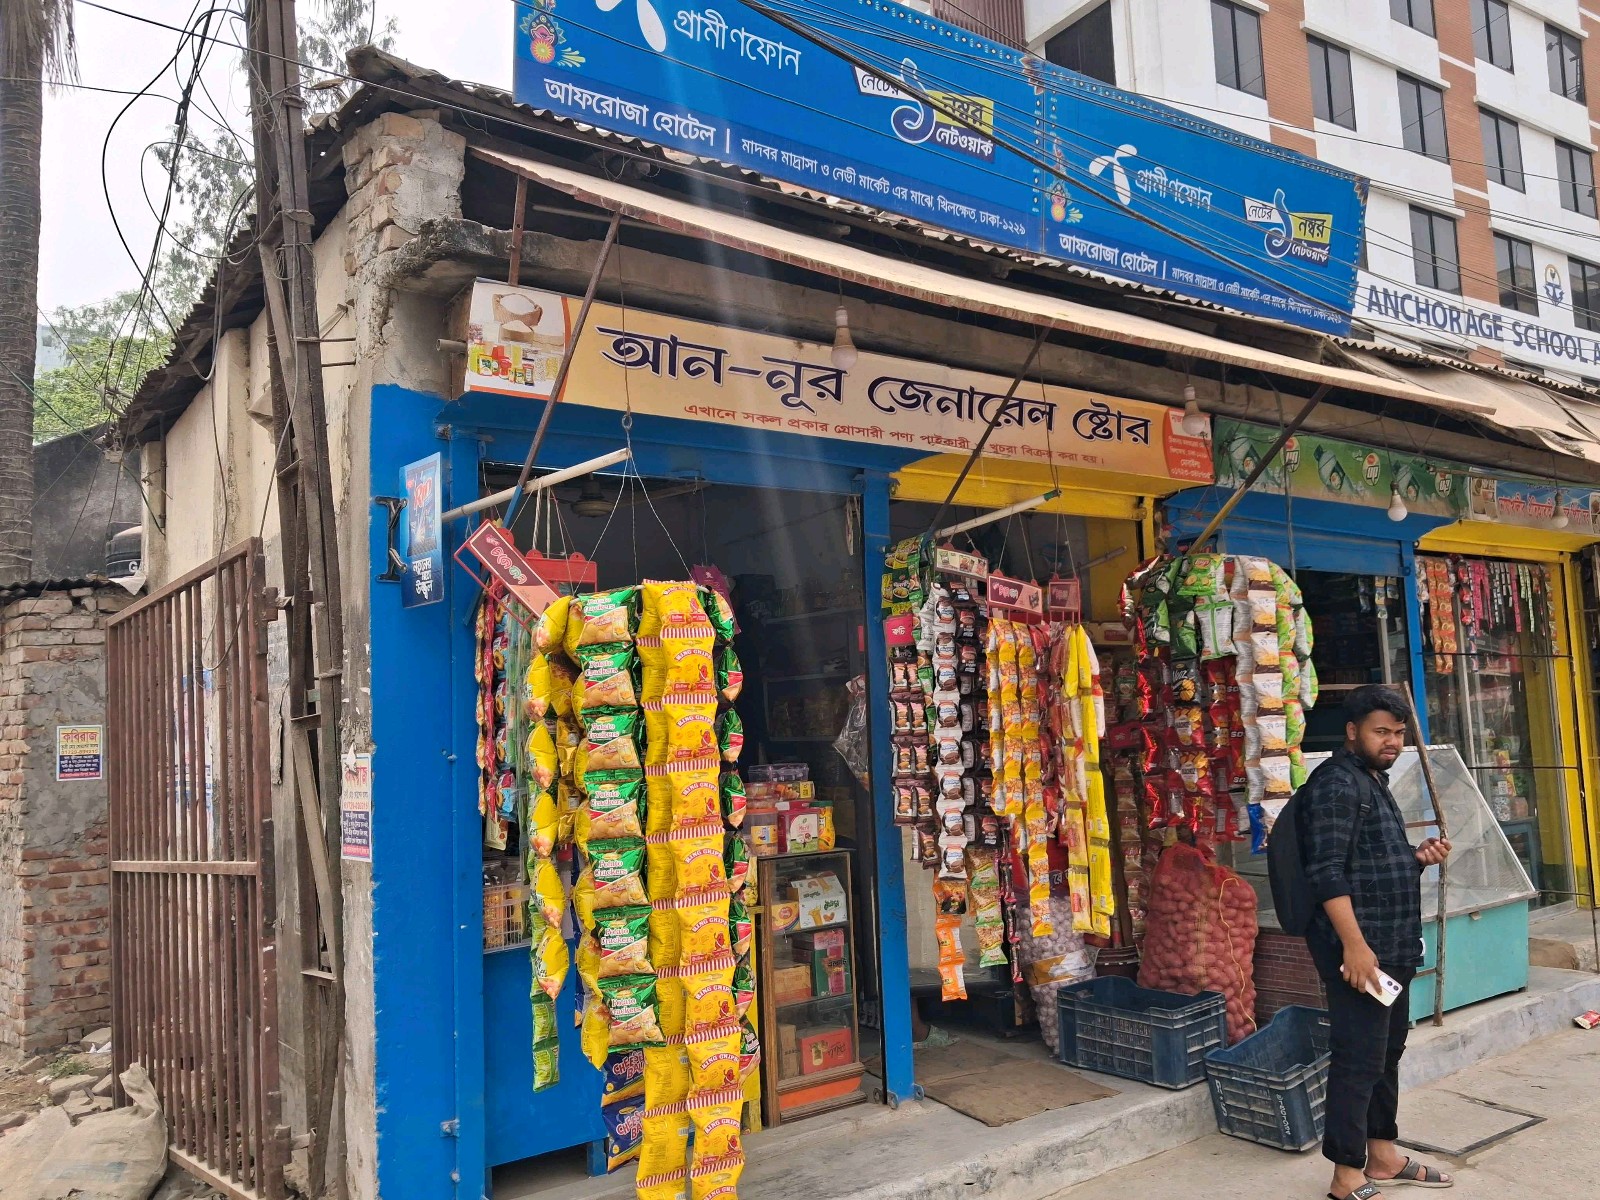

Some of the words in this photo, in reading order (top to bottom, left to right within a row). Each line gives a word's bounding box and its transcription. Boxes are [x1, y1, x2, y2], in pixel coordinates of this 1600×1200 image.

[674, 9, 801, 76] গ্রামীণফোন
[543, 78, 649, 127] আফরোজা
[653, 110, 717, 147] হোটেল
[936, 126, 993, 157] নেটওয়ার্ক
[742, 138, 778, 162] মাদবর
[781, 150, 817, 174] মাদ্রাসা
[821, 165, 830, 176] ও
[832, 167, 857, 186] নেভী
[859, 174, 890, 195] মার্কেট
[892, 186, 908, 201] এর
[1135, 166, 1213, 212] গ্রামীণফোন
[1059, 233, 1119, 267] আফরোজা
[1121, 251, 1158, 276] হোটেল
[1367, 285, 1505, 342] ANCHORAGE
[1511, 321, 1588, 364] SCHOOL
[684, 404, 737, 421] এখানে
[741, 412, 783, 427] সকল
[788, 418, 829, 433] প্রকার
[868, 376, 1057, 433] জেনারেল
[61, 729, 99, 743] কবিরাজ
[598, 860, 624, 868] Potato
[604, 928, 630, 936] Potato
[692, 918, 708, 932] RING
[600, 935, 635, 945] Crackers
[695, 985, 712, 1000] RING
[616, 1111, 643, 1136] CHEES
[704, 1119, 721, 1134] RING
